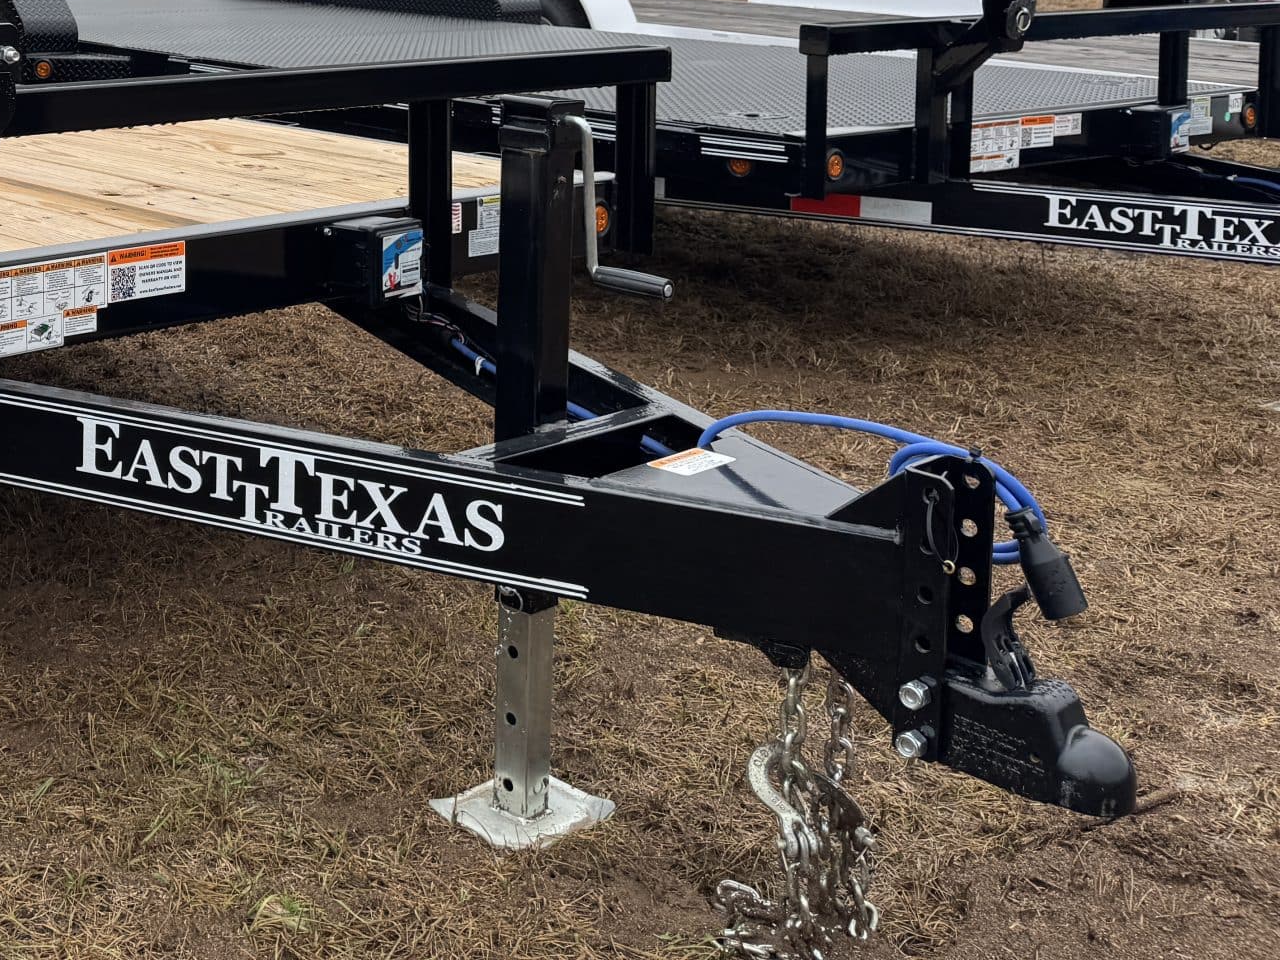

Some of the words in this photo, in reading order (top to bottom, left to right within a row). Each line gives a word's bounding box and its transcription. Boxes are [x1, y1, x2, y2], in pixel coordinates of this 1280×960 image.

[1044, 194, 1163, 236] EAST
[1173, 204, 1280, 247] TEX
[1154, 223, 1280, 257] TRAILERS
[75, 416, 243, 502] EAST
[259, 446, 505, 553] TEXAS
[232, 479, 423, 556] TRAILERS
